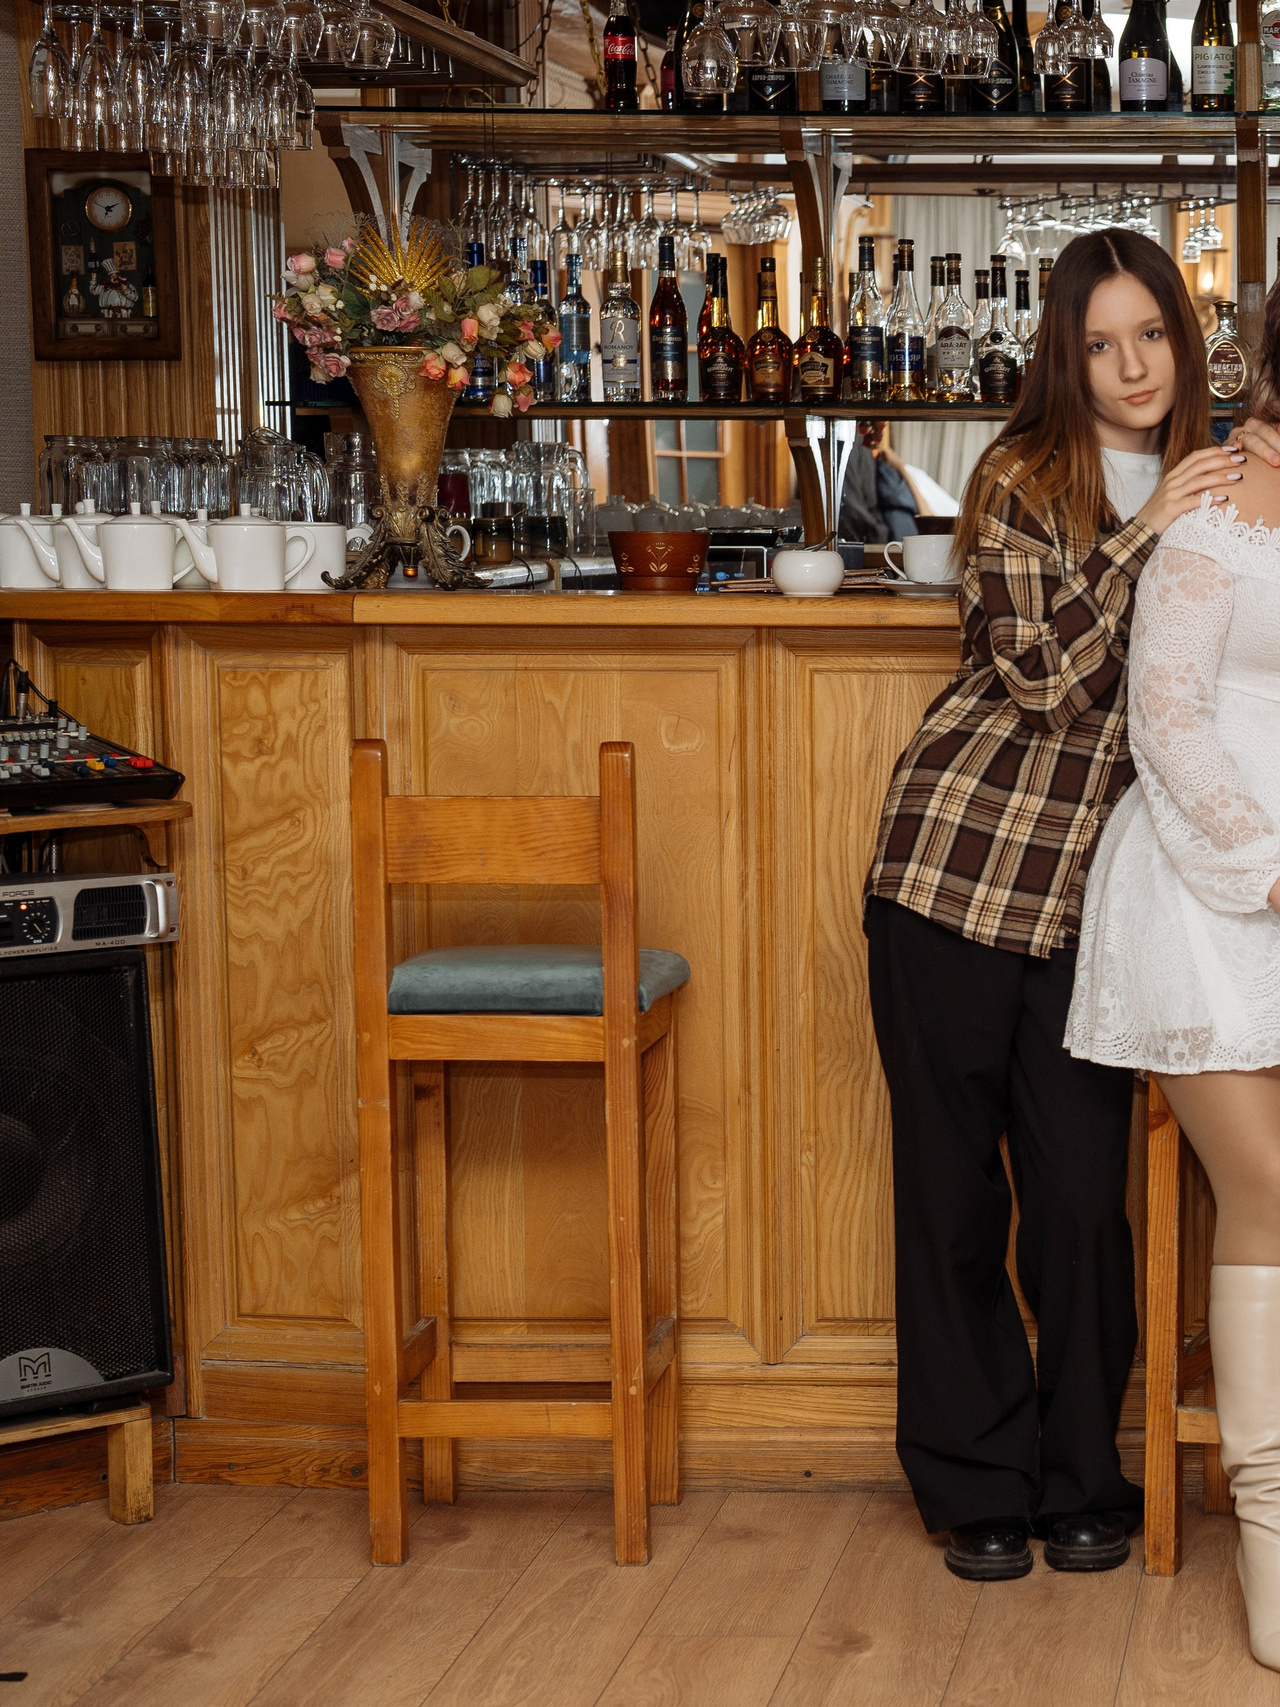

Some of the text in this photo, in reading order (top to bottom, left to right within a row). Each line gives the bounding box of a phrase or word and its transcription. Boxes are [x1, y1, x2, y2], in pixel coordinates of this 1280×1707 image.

[608, 43, 635, 55] Coca-Cola
[2, 889, 35, 898] FORCE
[95, 939, 126, 947] MA-400
